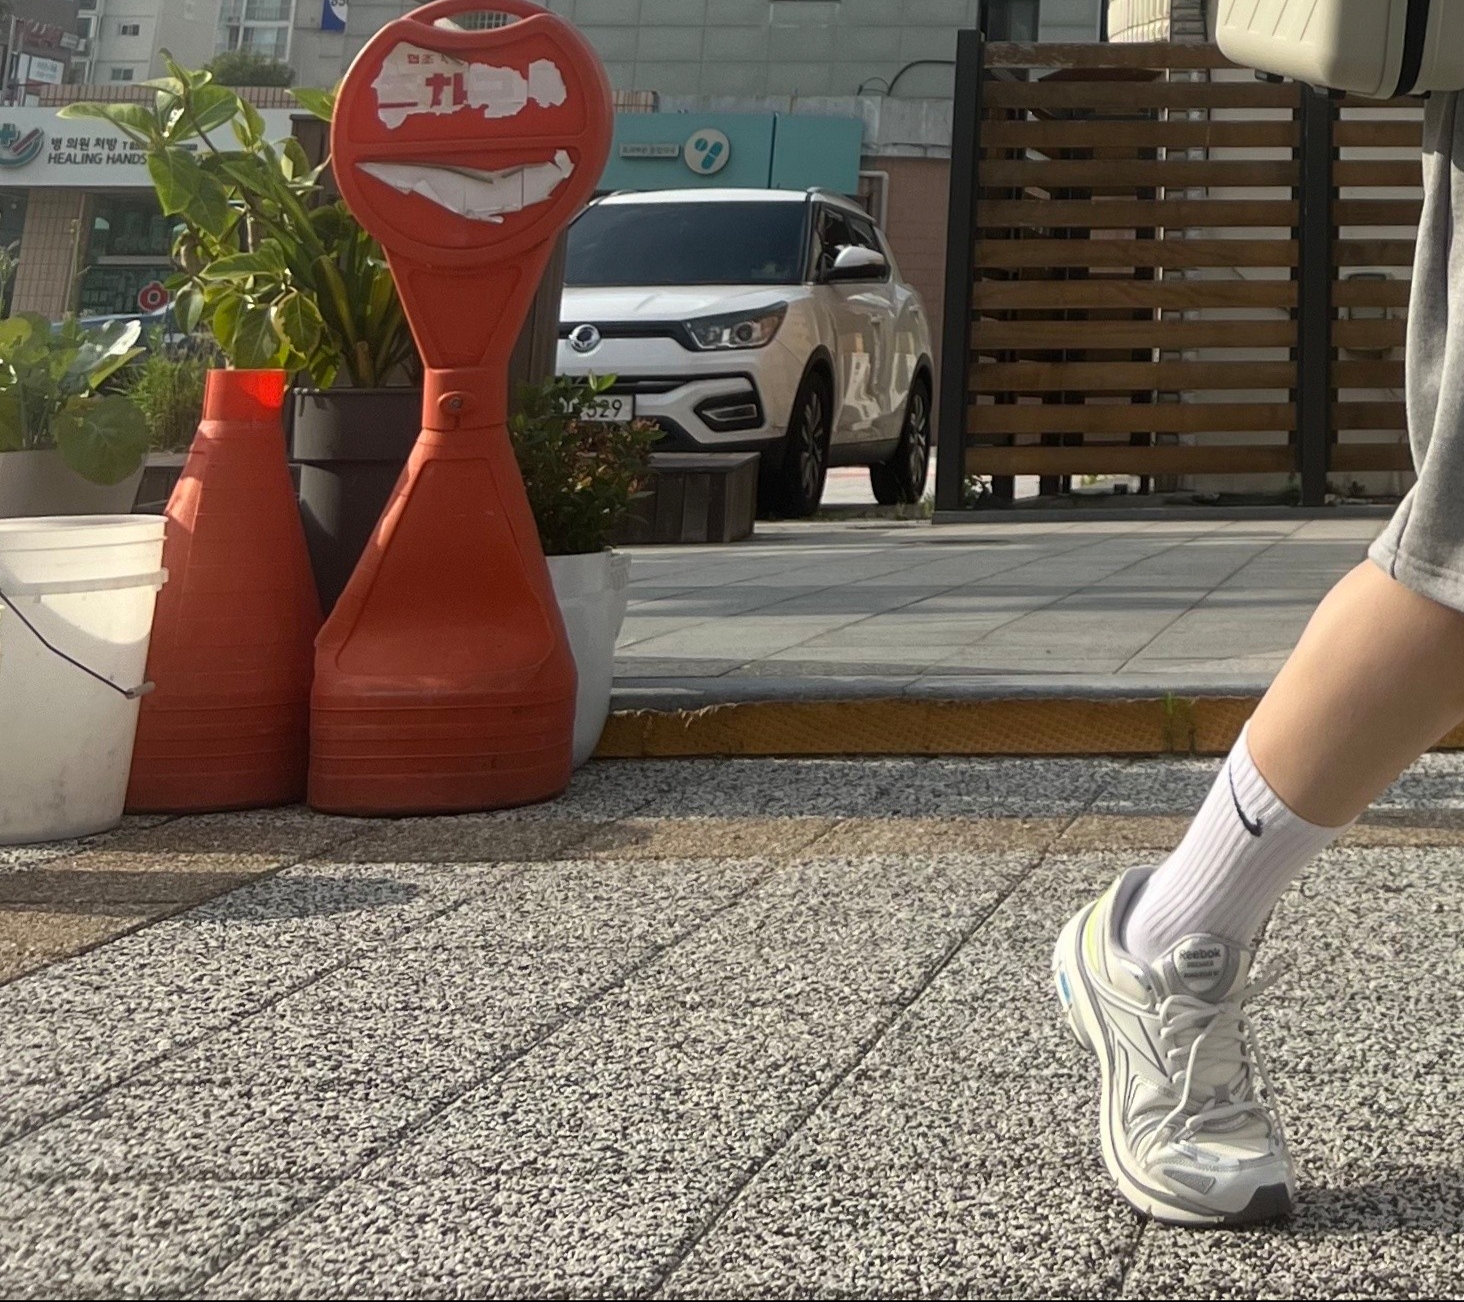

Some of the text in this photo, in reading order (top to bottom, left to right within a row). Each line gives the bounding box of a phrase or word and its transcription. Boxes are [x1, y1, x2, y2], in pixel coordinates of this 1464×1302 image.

[48, 152, 147, 165] HEALING HANDS
[1179, 947, 1221, 960] Reebok
